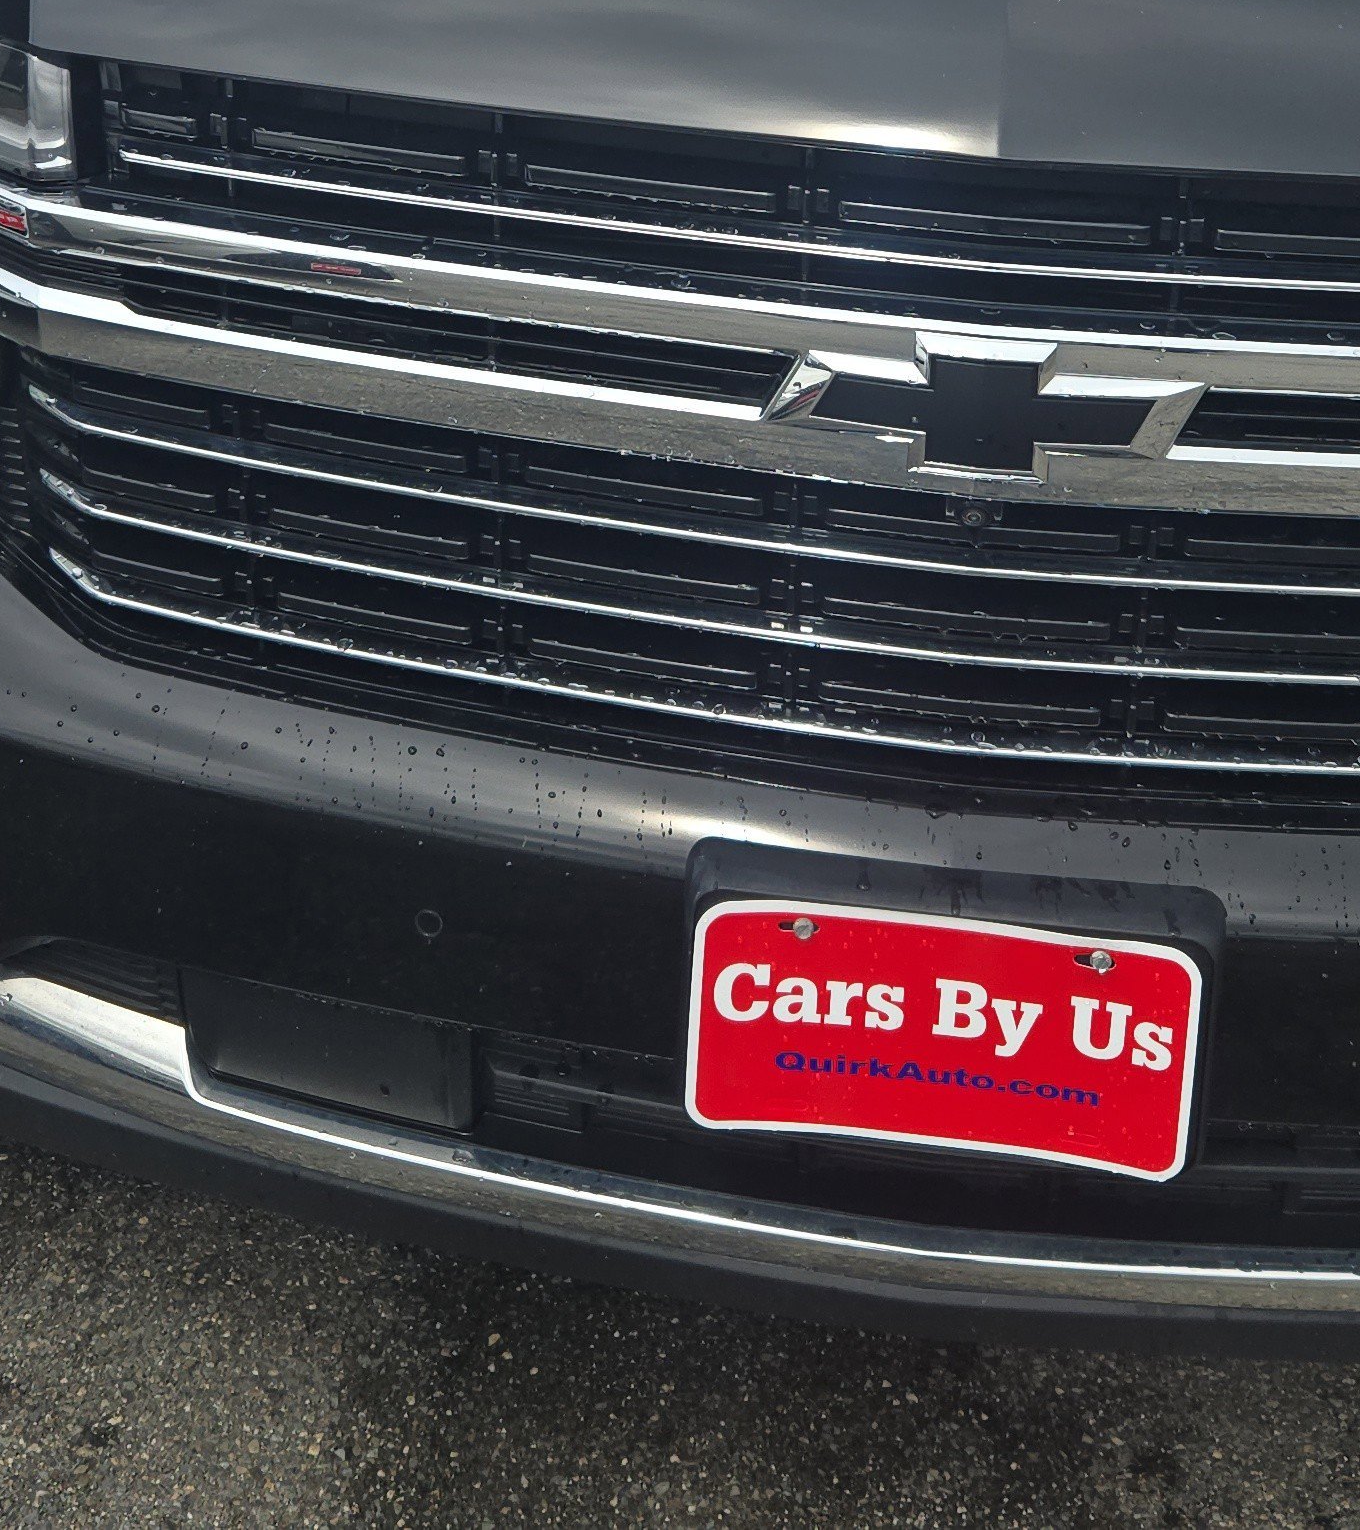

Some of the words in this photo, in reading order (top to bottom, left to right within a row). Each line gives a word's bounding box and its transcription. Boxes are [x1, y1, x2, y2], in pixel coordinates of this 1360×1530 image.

[713, 962, 905, 1031] Cars
[931, 978, 1043, 1057] By
[1070, 996, 1174, 1071] Us
[774, 1051, 1100, 1107] QuirkAuto.com
